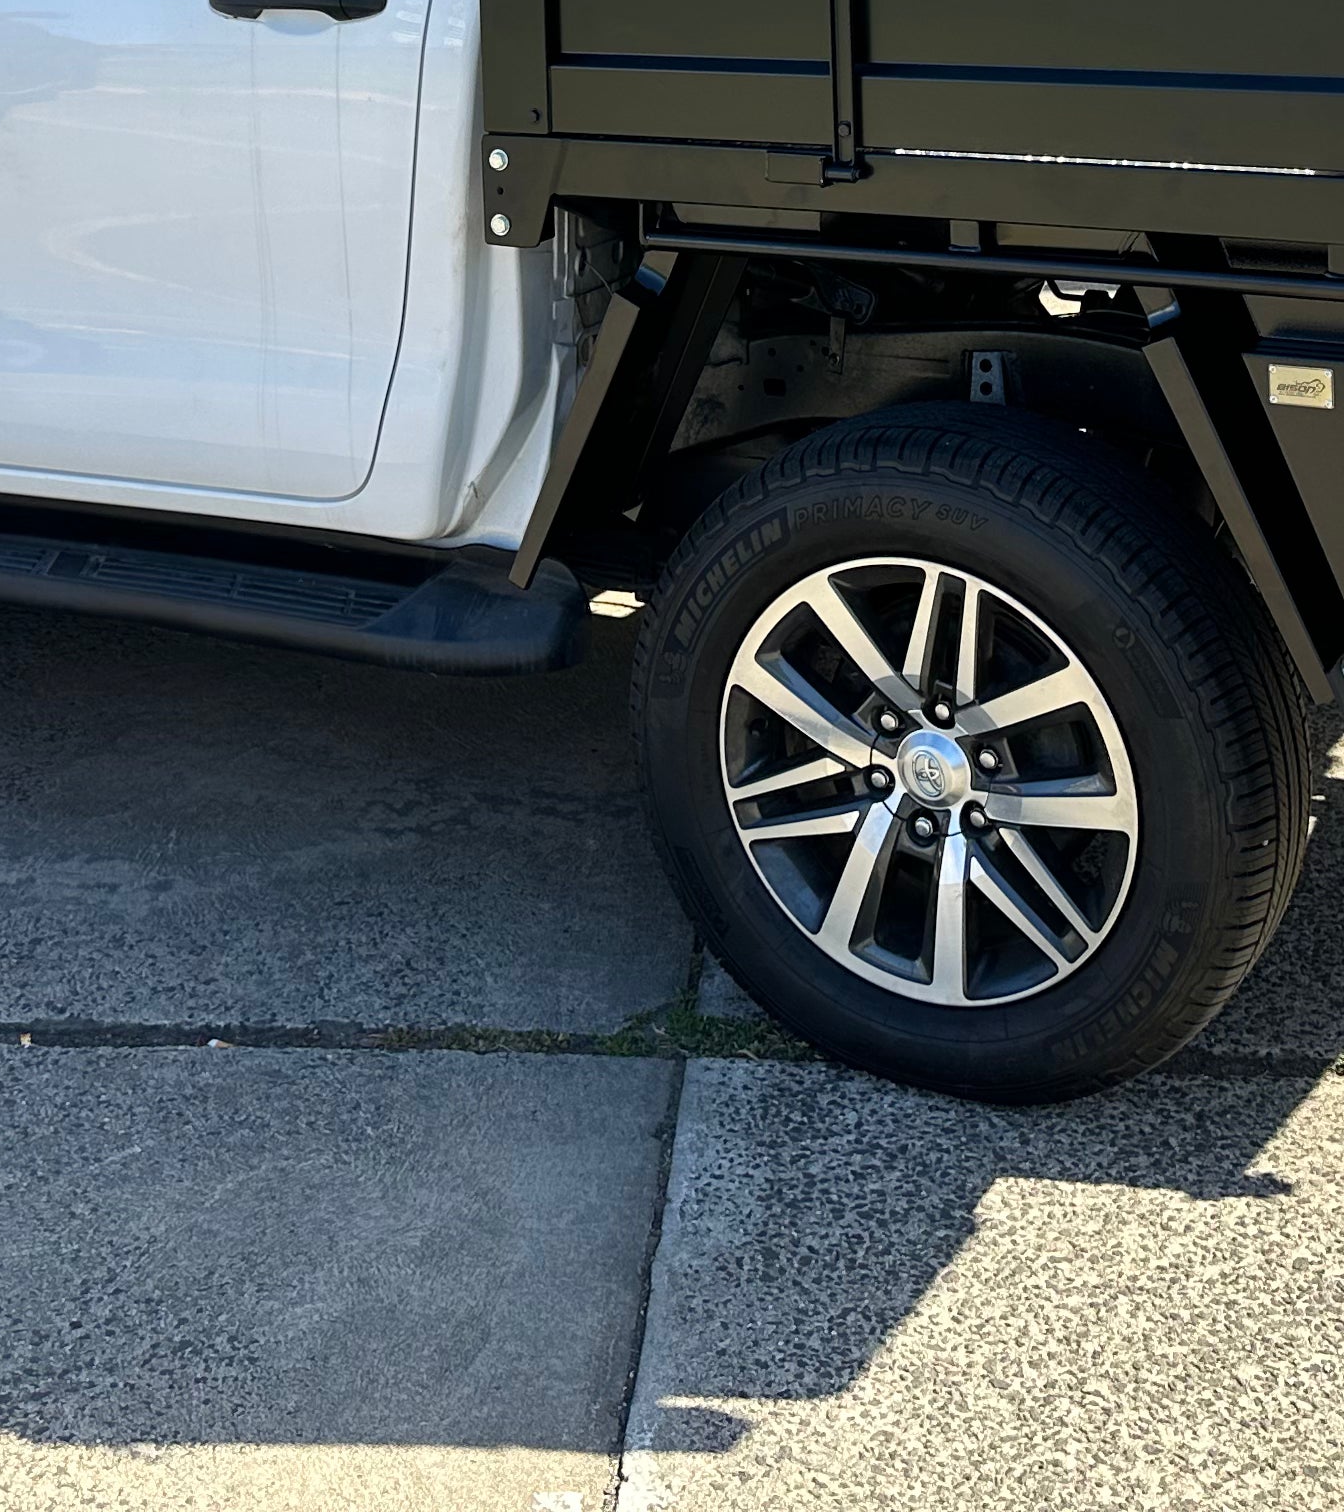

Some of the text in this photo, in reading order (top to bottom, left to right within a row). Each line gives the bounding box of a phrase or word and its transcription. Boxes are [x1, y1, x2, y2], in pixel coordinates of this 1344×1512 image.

[672, 492, 989, 646] MICHELIN PRIMACY SUV
